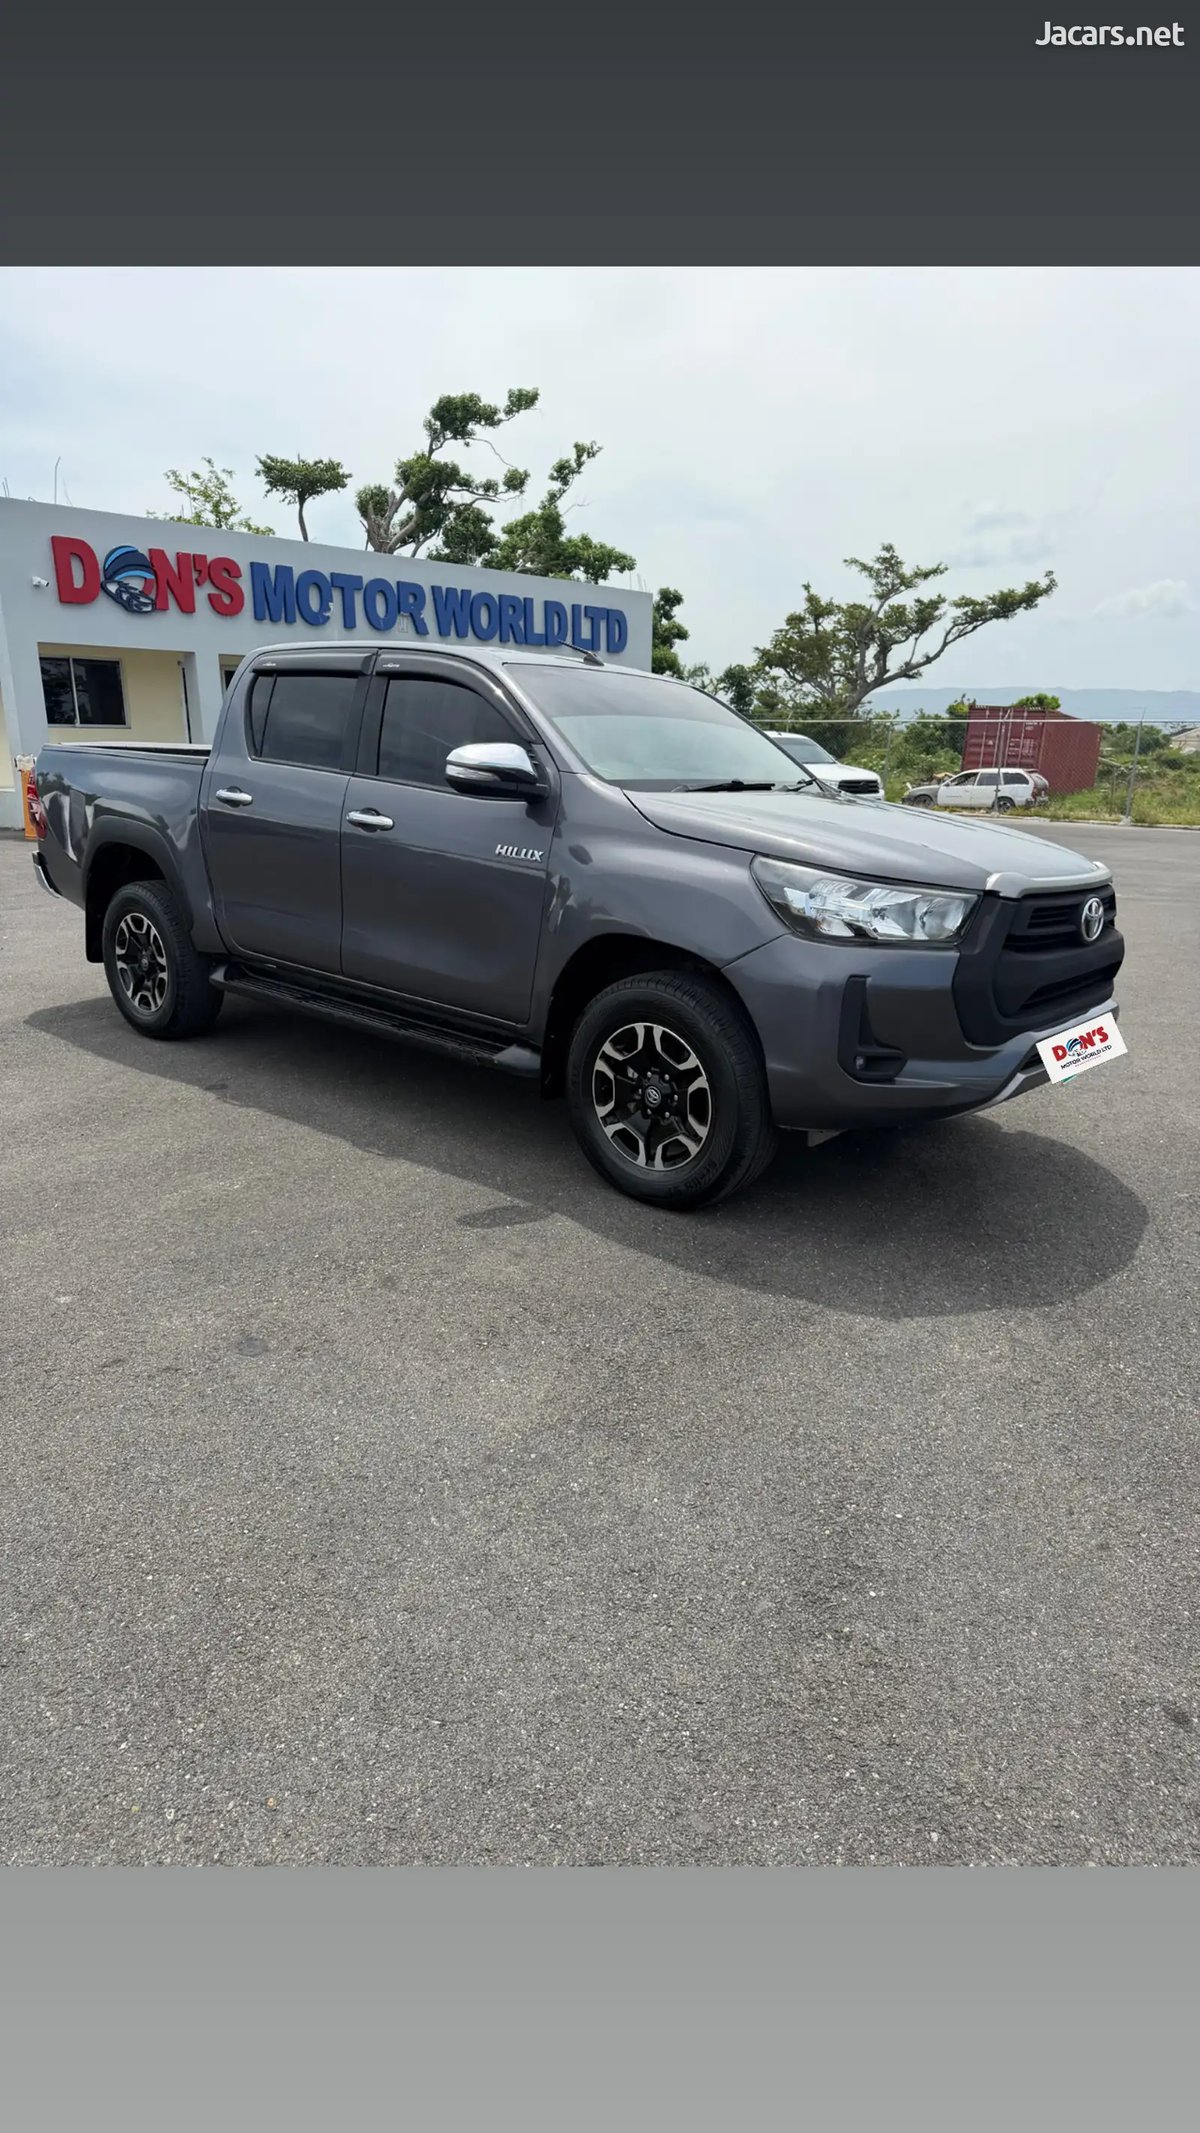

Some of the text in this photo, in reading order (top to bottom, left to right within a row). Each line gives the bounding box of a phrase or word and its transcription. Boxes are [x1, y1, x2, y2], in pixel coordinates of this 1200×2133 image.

[250, 562, 429, 635] MOTOR
[431, 585, 568, 647] WORLD
[572, 604, 628, 653] LTD
[495, 844, 544, 862] HILUX
